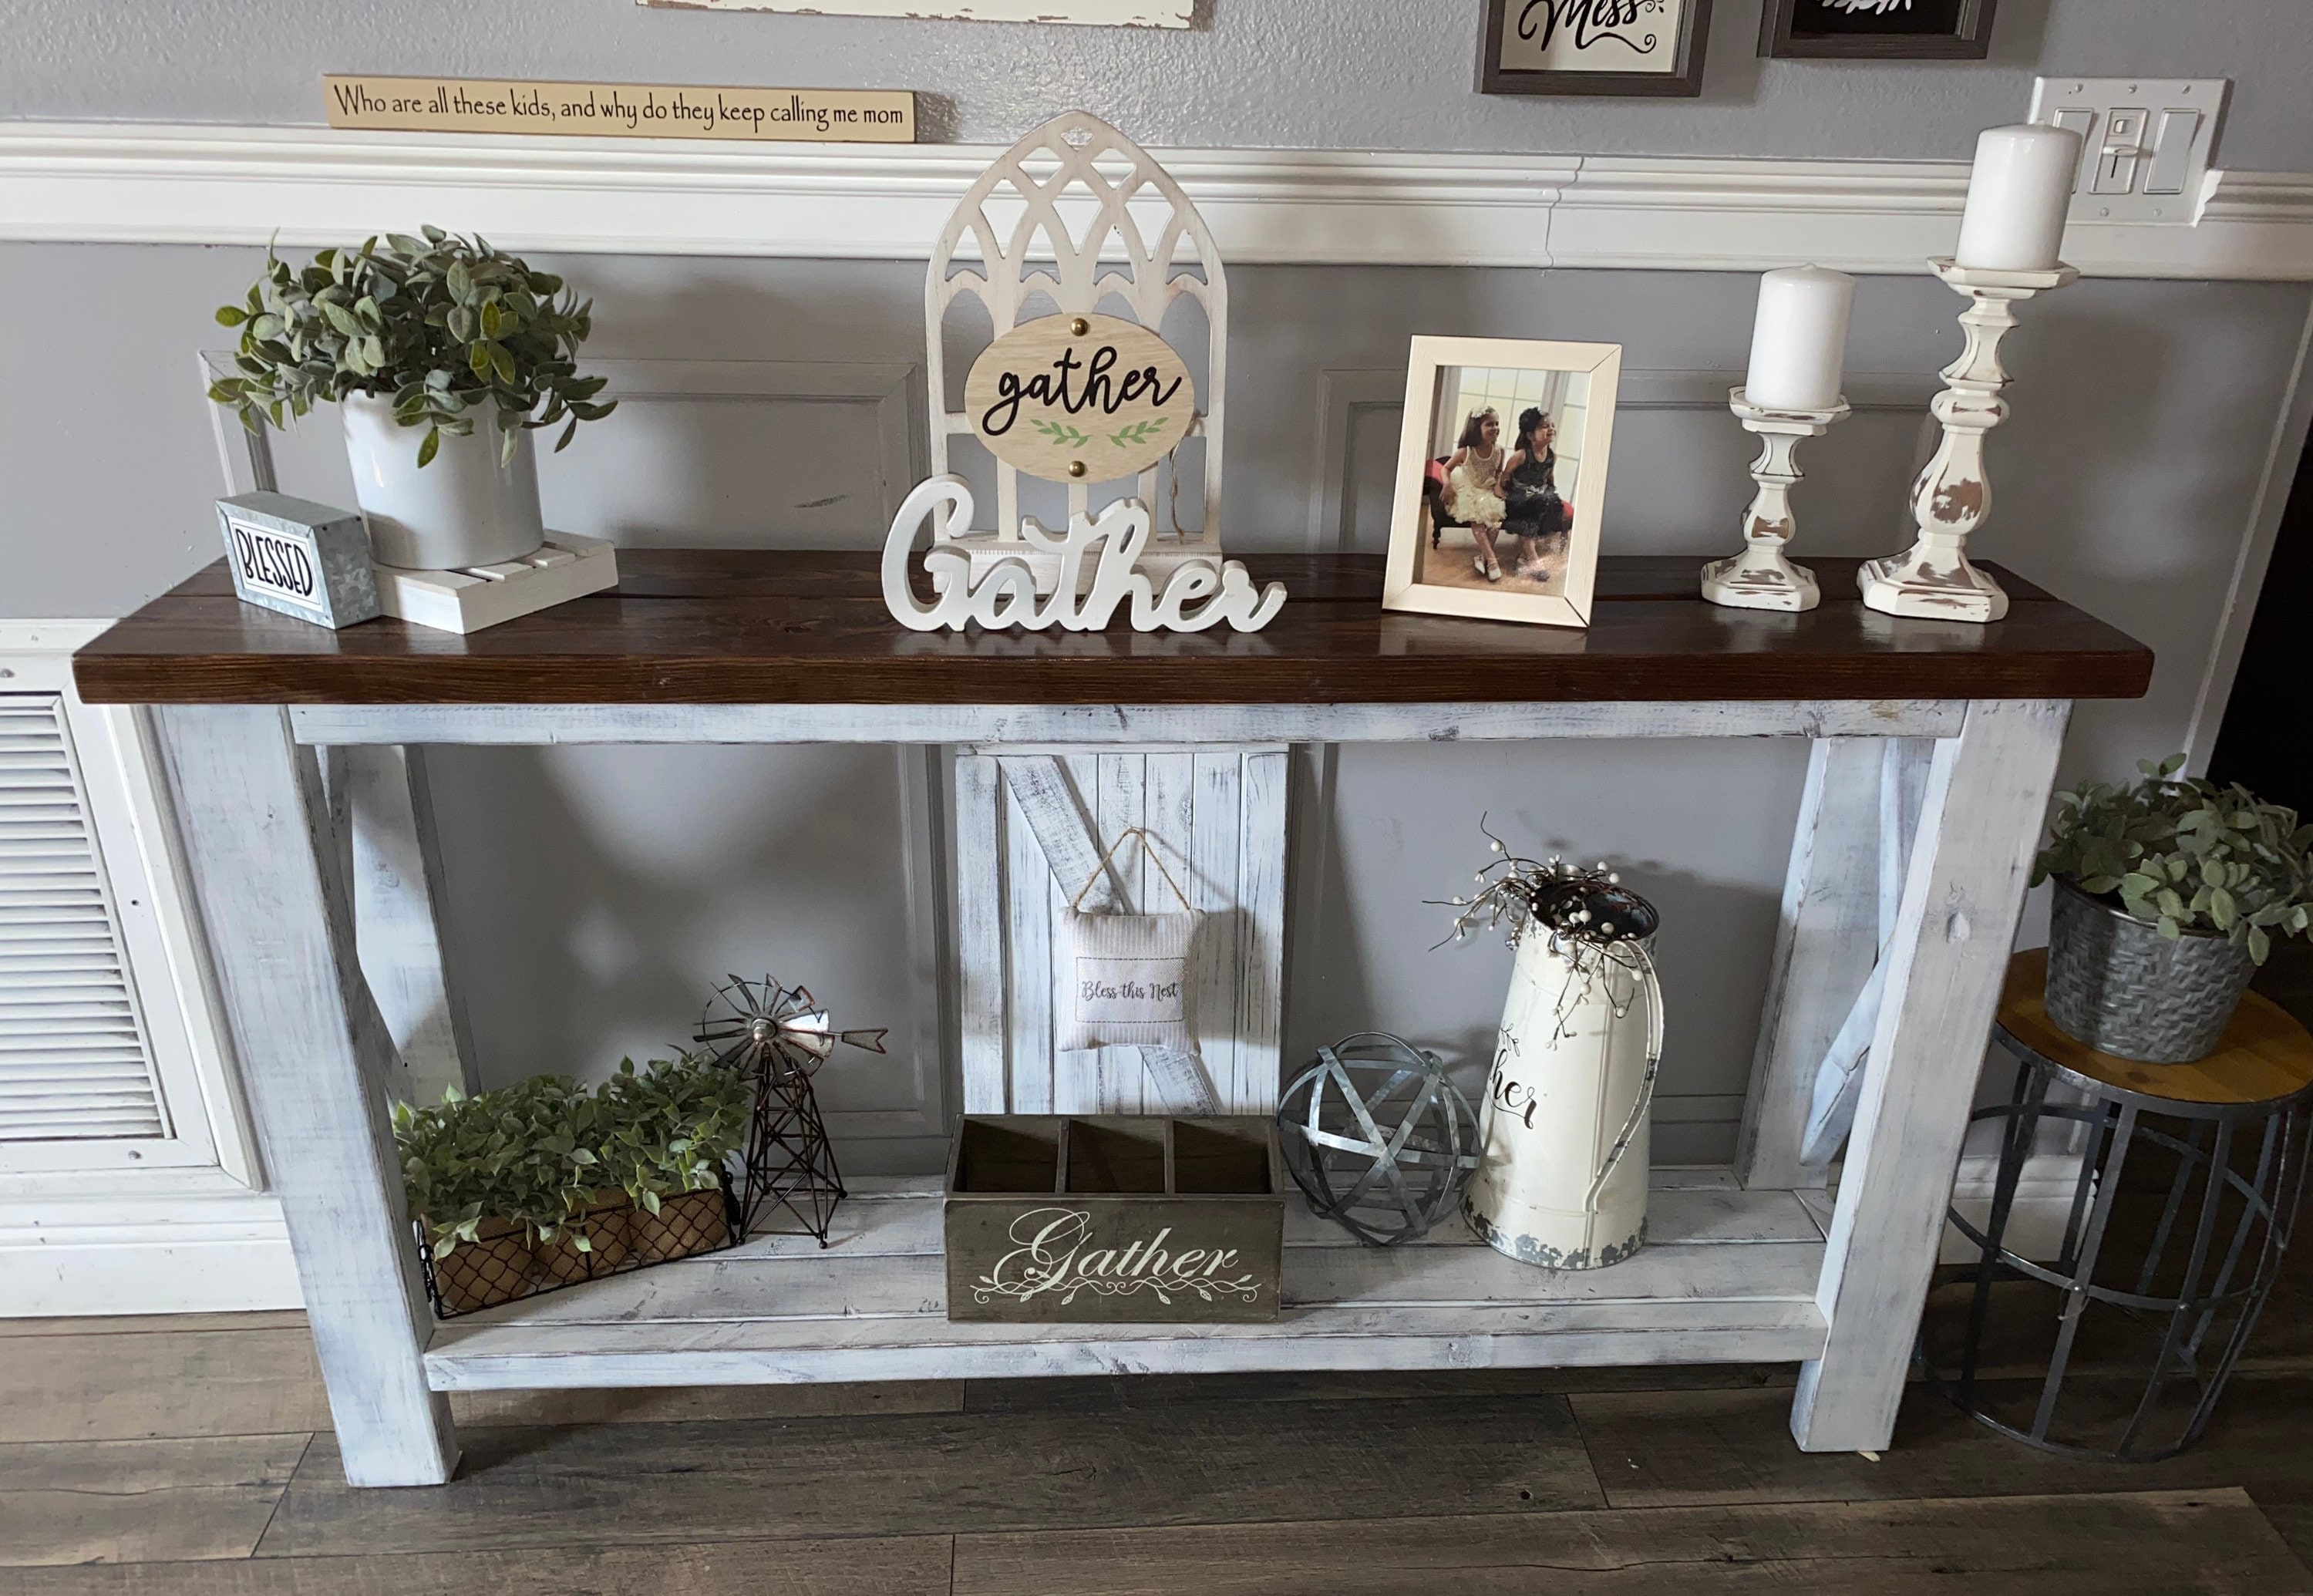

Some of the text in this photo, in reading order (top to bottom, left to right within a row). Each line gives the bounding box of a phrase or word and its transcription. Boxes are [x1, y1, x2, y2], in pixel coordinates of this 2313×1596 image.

[334, 84, 903, 133] Who are all these kids, and why do they keep calling me mom
[981, 345, 1182, 436] gather
[235, 527, 313, 597] BLESSED
[881, 473, 1288, 634] Gather
[1082, 981, 1180, 1002] Bless this Nest
[1489, 1037, 1537, 1130] her
[993, 1207, 1240, 1295] Gather
